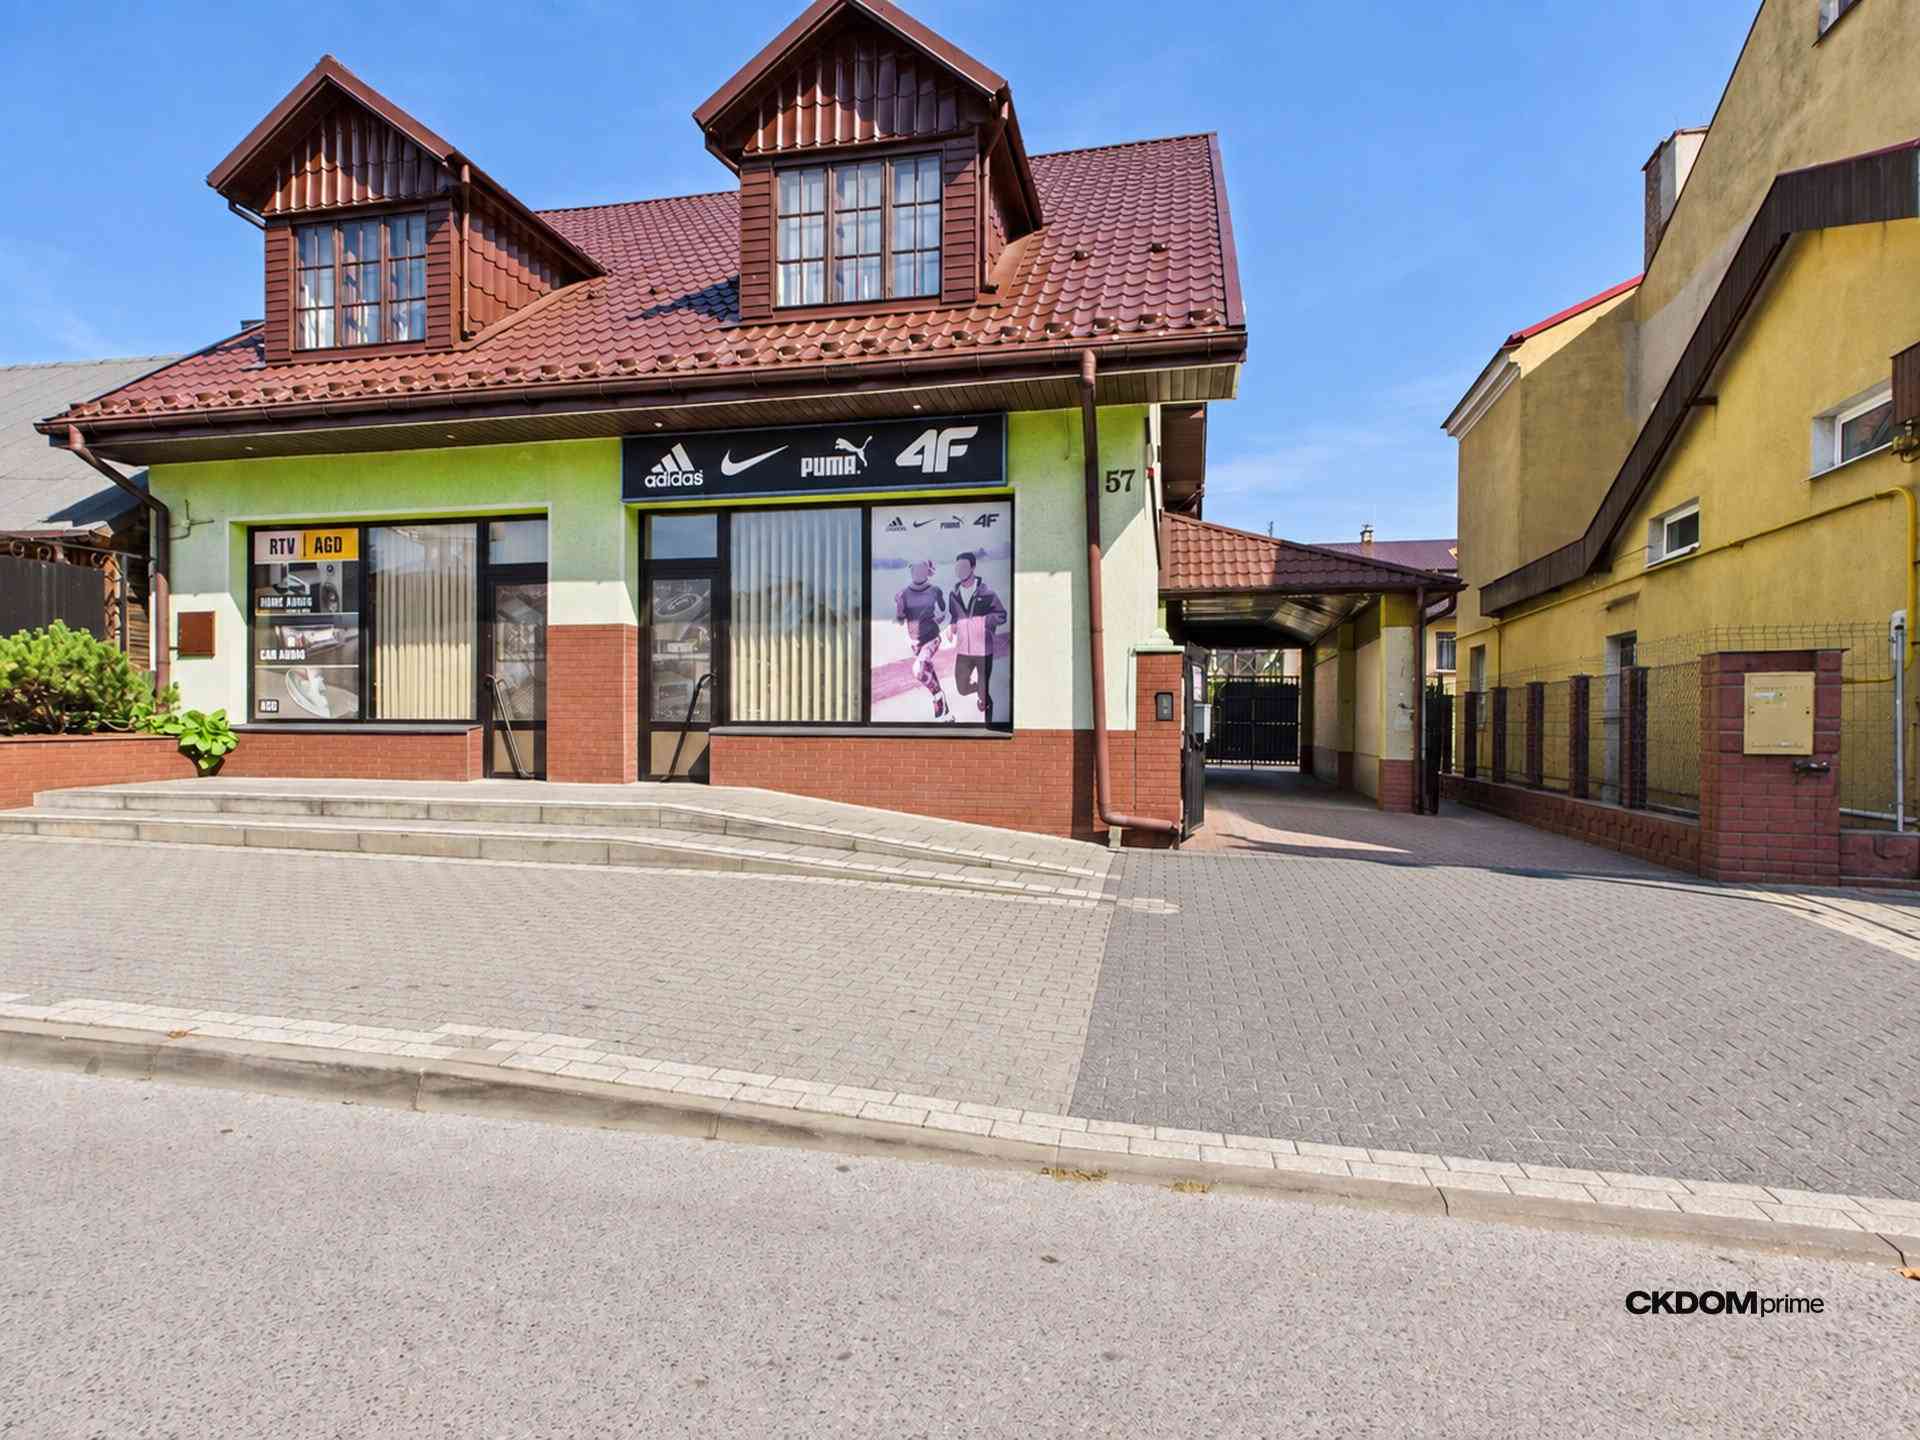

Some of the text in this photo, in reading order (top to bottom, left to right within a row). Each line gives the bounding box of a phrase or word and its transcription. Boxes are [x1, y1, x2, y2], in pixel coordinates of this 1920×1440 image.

[895, 425, 979, 473] 4F
[644, 472, 703, 488] adidas
[1105, 469, 1136, 493] 57
[974, 513, 1000, 528] 4F
[269, 536, 342, 555] RTV AGD
[260, 649, 305, 660] CAR AUDIO
